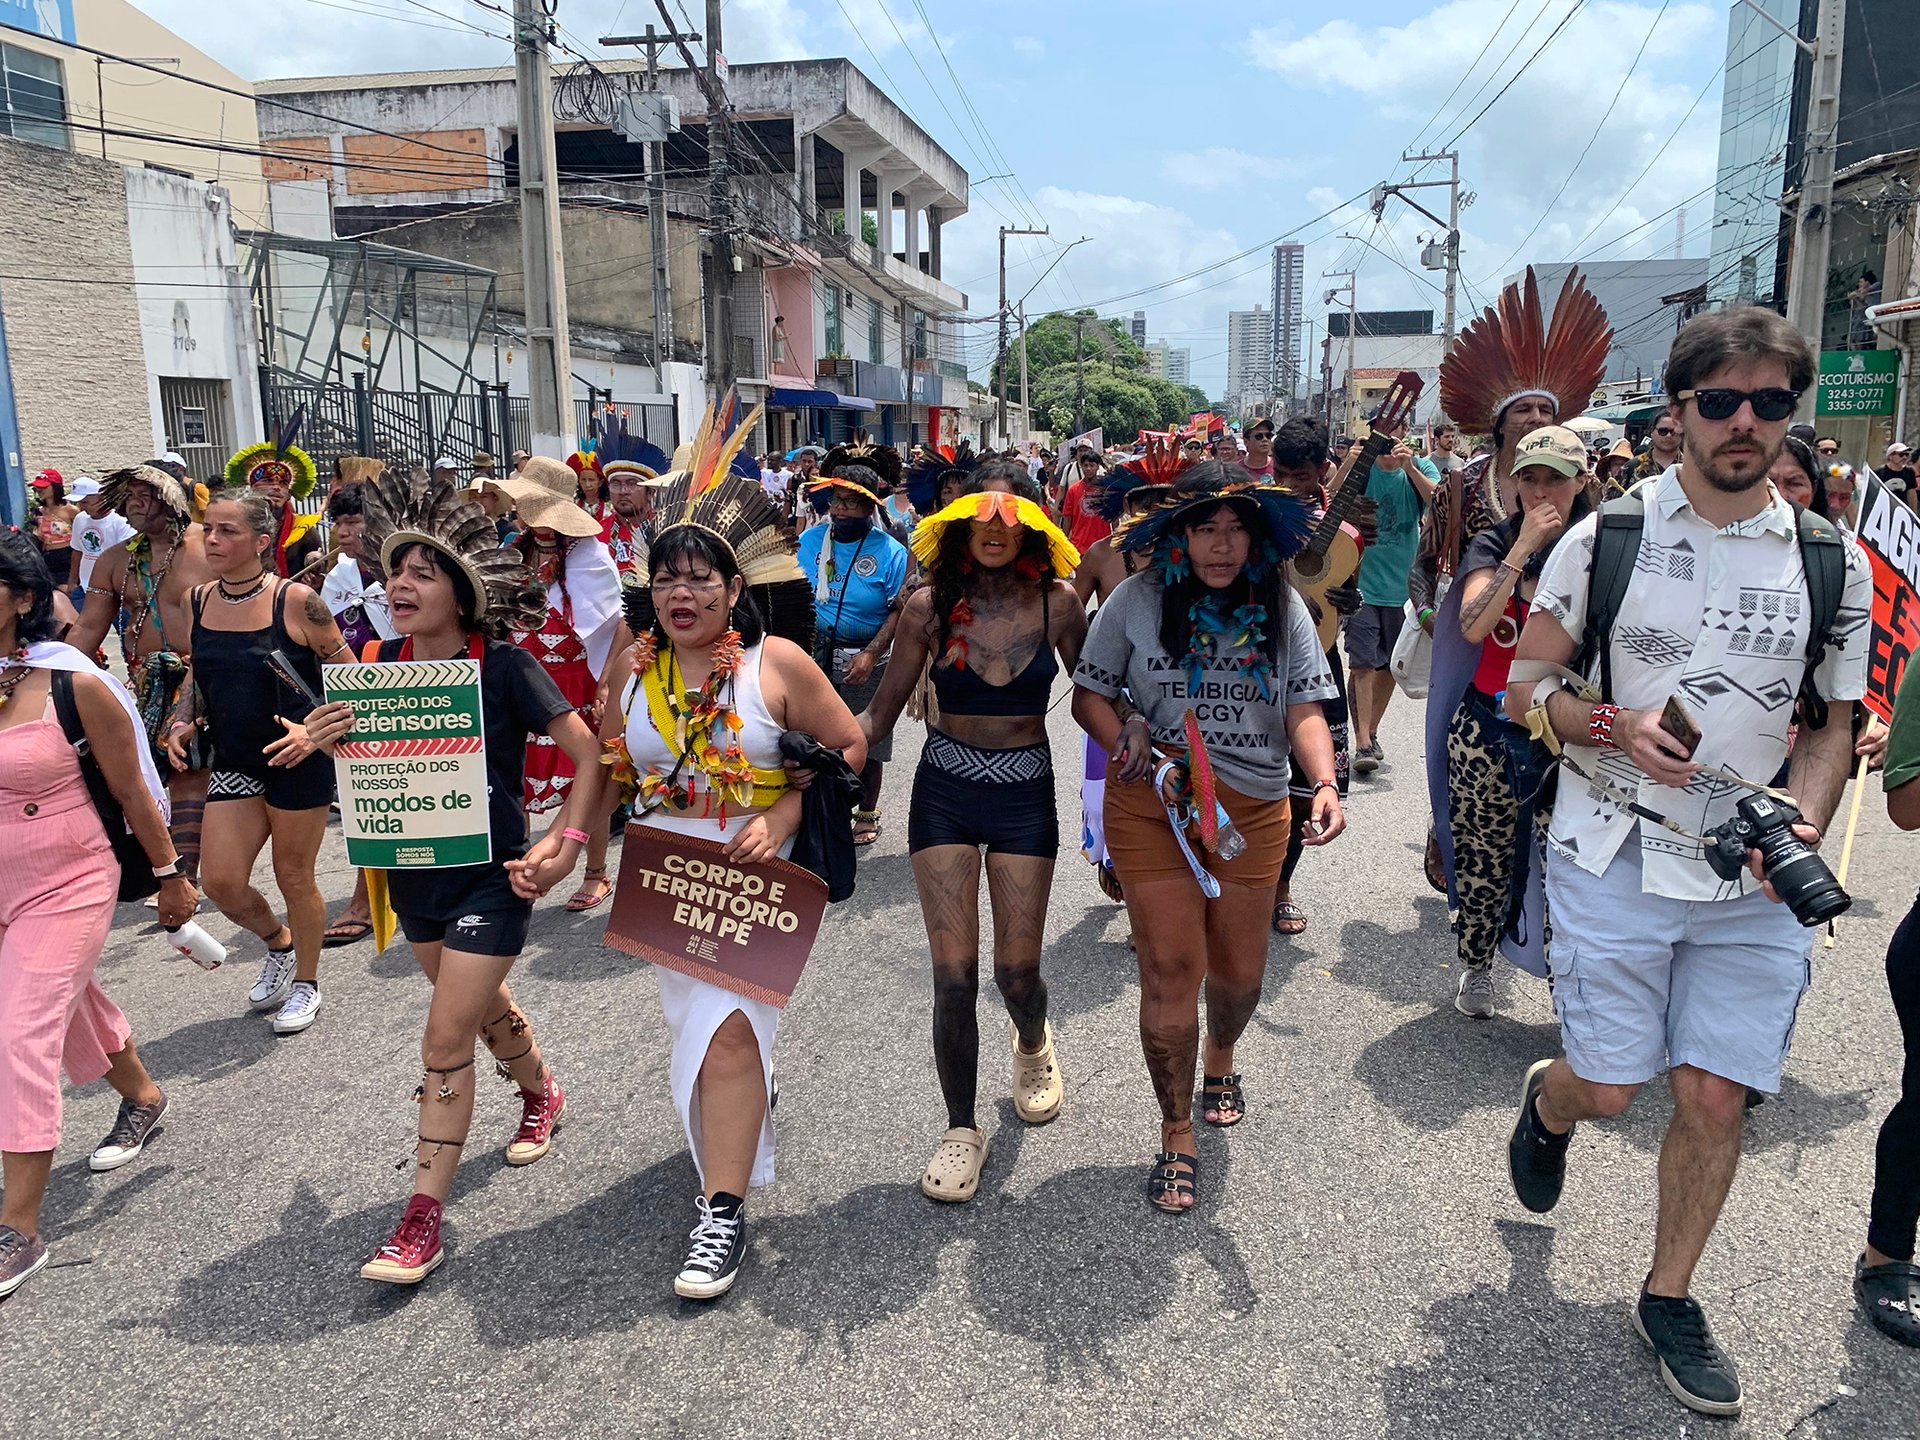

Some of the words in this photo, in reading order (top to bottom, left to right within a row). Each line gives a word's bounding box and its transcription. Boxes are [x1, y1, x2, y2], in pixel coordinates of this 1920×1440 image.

[1818, 372, 1895, 386] ECOTURISMO
[1827, 388, 1884, 399] 3243-0771
[1827, 400, 1882, 411] 3355-0771
[421, 695, 452, 708] DOS
[350, 760, 427, 777] PROTEÇÃO
[430, 760, 460, 773] DOS
[352, 778, 409, 790] NOSSOS
[354, 792, 436, 813] modos
[441, 790, 472, 810] de
[356, 814, 404, 834] vida
[664, 854, 765, 896] CORPO
[768, 881, 786, 904] E
[639, 868, 799, 933] TERRITÓRIO
[673, 902, 717, 934] EM
[717, 917, 753, 947] PÉ
